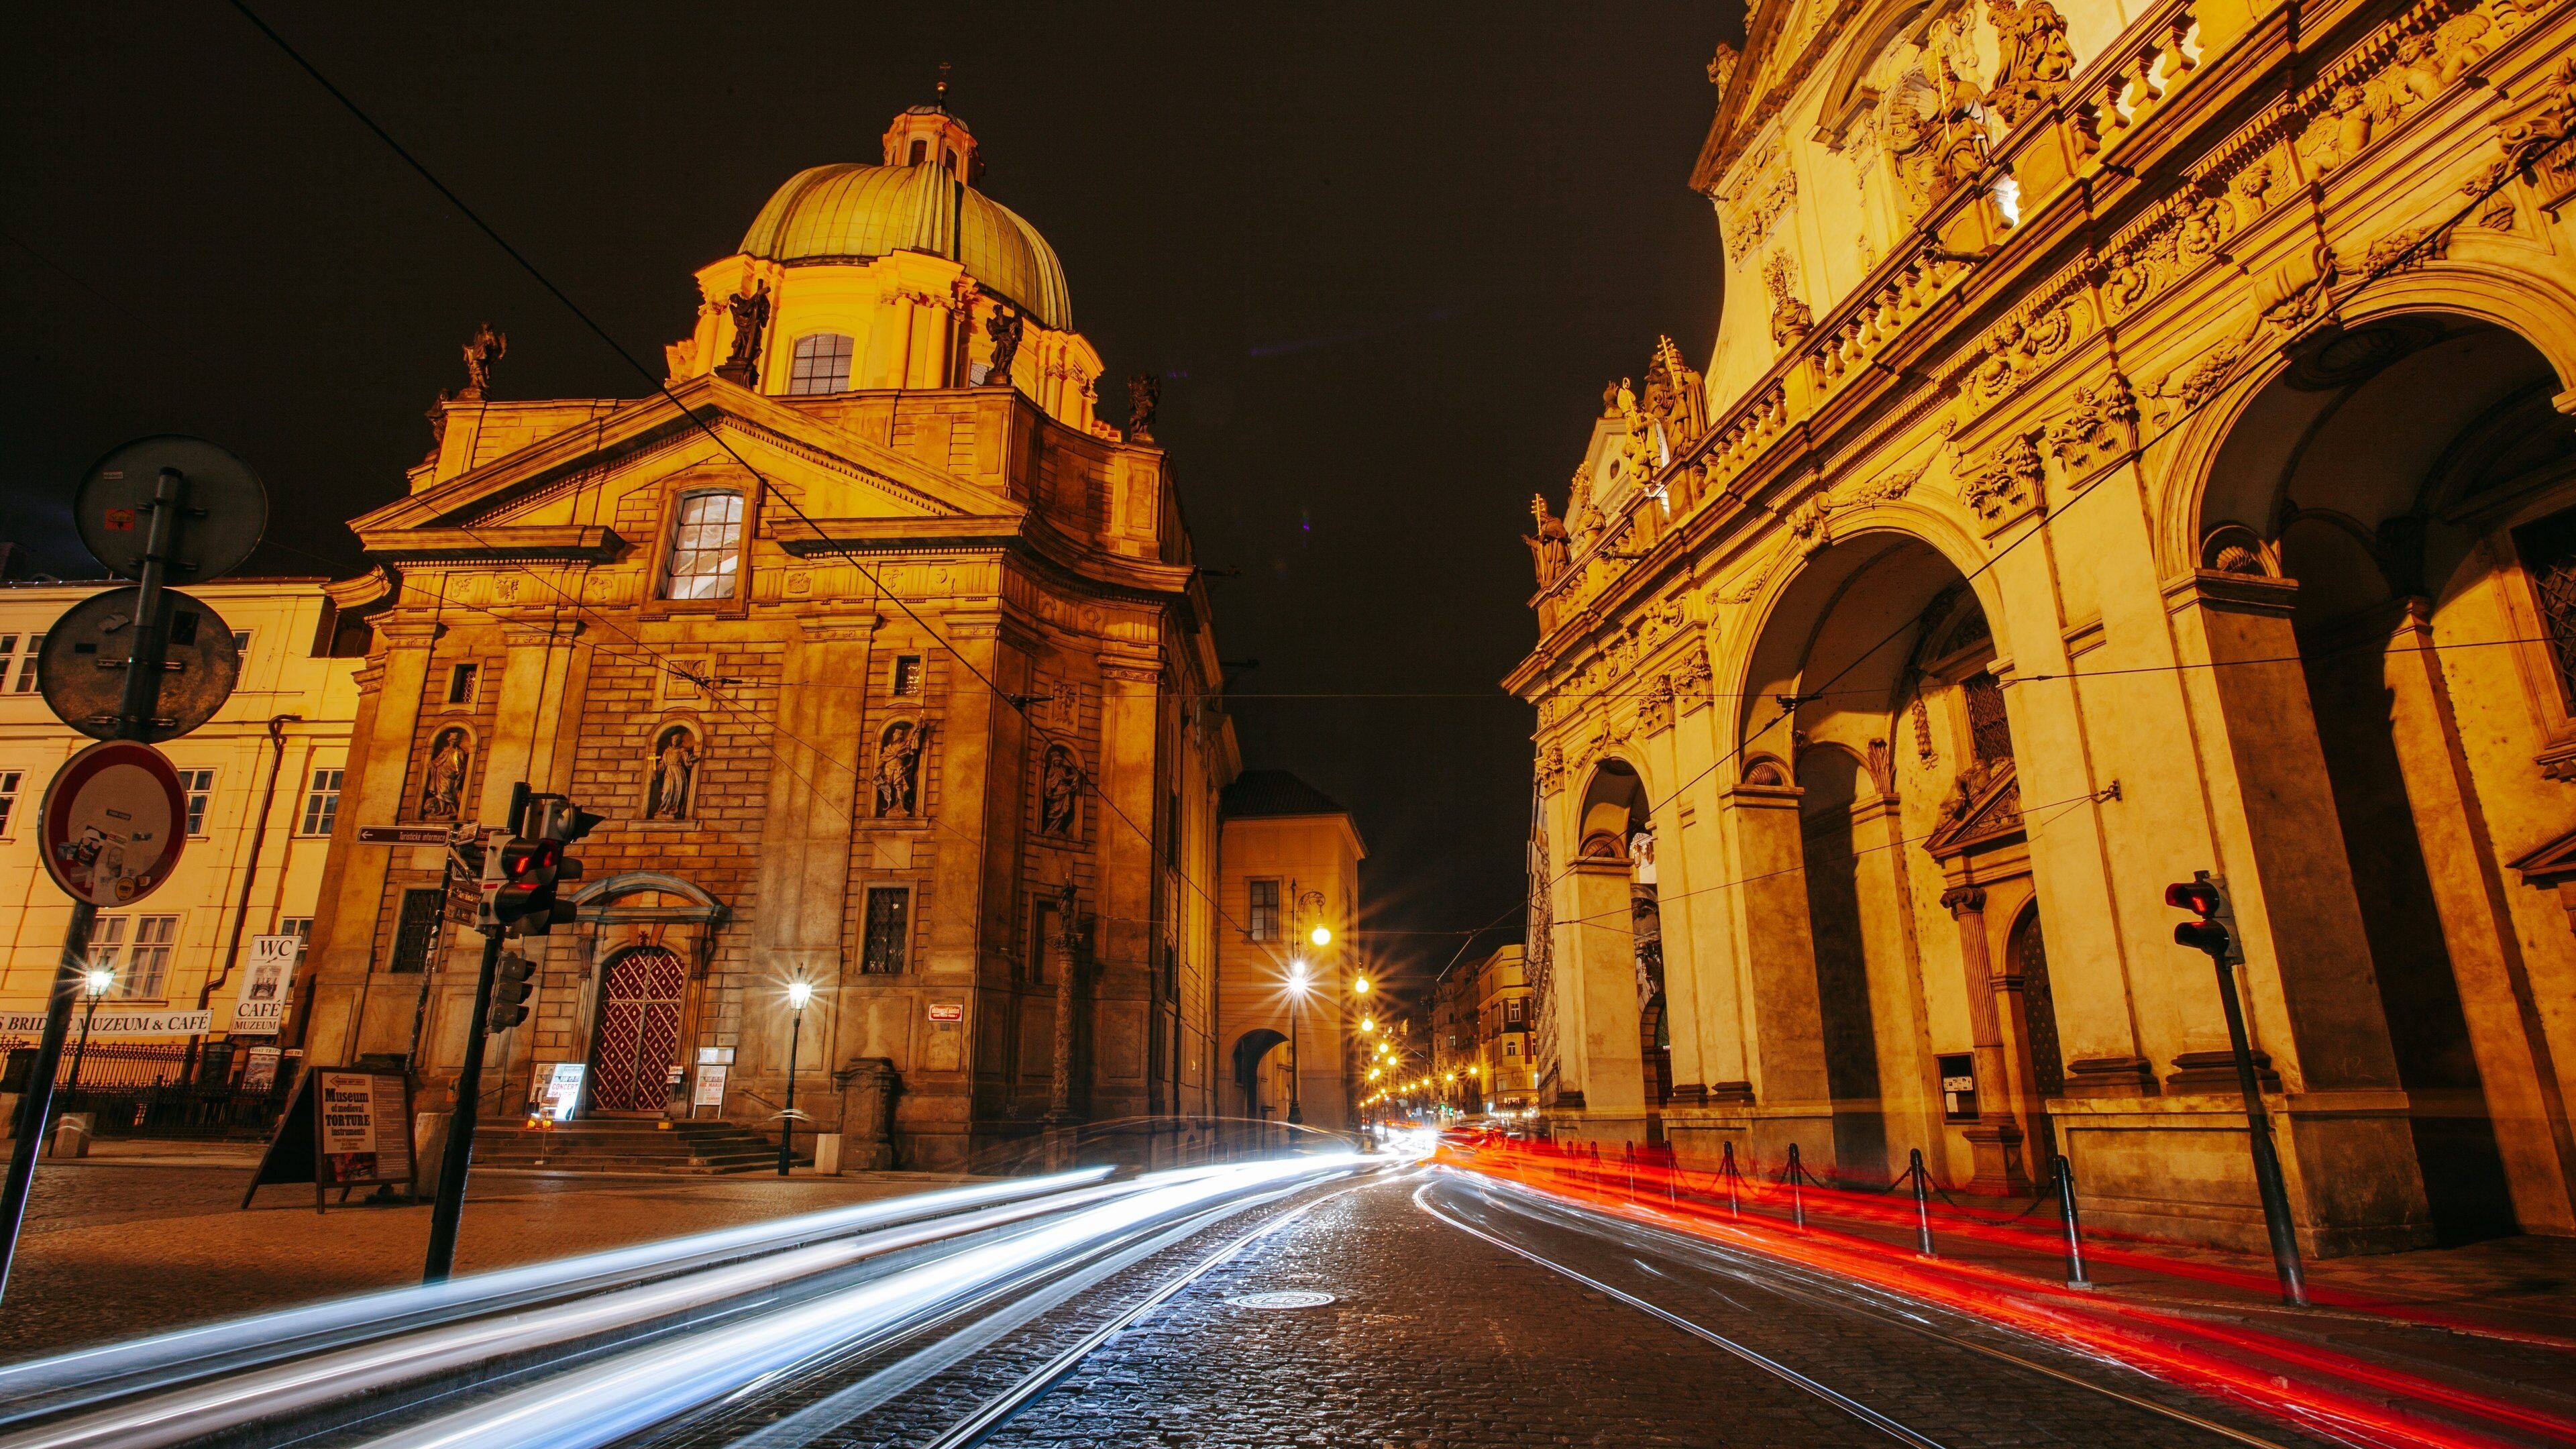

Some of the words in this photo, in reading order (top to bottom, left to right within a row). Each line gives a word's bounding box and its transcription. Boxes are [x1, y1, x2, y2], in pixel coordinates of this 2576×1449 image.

[399, 831, 421, 841] Turistické
[423, 833, 445, 842] informace
[260, 940, 292, 956] WC
[237, 1000, 281, 1017] CAFÉ
[7, 1016, 72, 1031] BRID
[76, 1017, 150, 1031] MUZEUM
[154, 1018, 163, 1030] &
[167, 1013, 209, 1030] CAFÉ
[234, 1021, 276, 1030] MUZEUM
[325, 1088, 369, 1102] Museum
[331, 1104, 337, 1112] of
[338, 1104, 364, 1112] medieval
[325, 1114, 370, 1126] TORTURE
[331, 1128, 366, 1136] instruments
